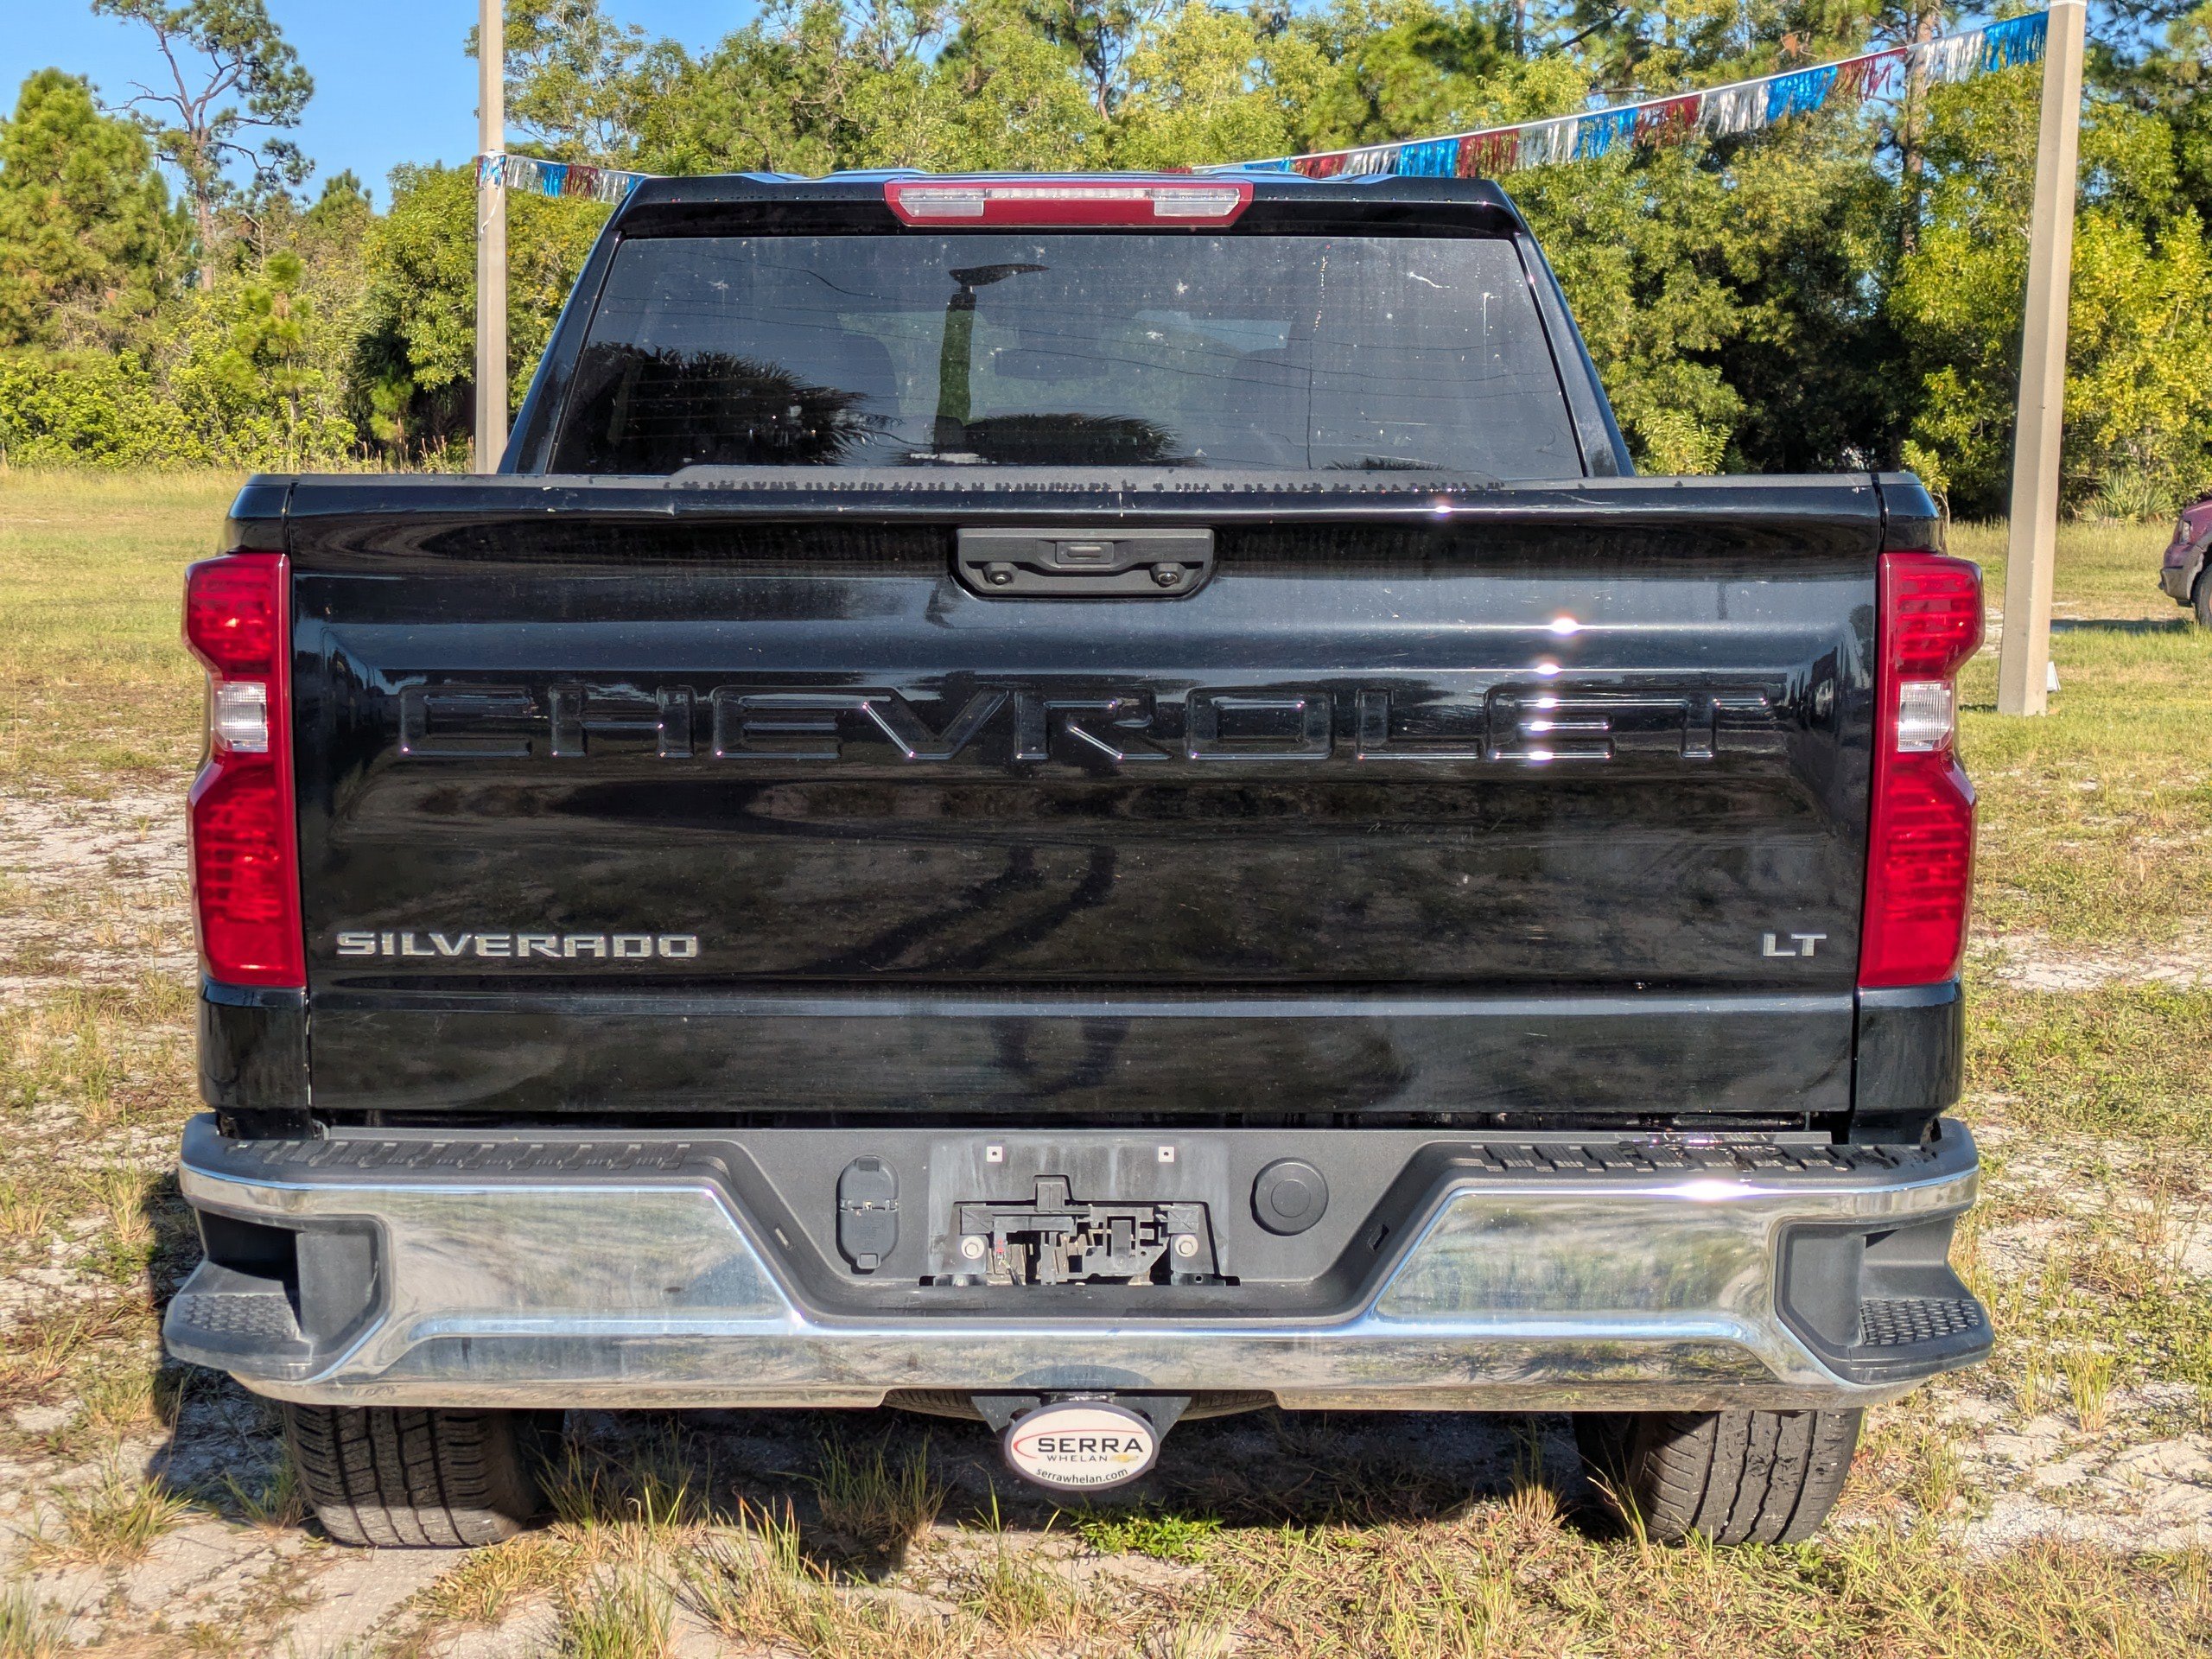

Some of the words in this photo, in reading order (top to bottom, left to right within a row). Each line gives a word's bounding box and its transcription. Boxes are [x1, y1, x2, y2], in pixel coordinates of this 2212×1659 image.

[398, 684, 1768, 760] CHEVROLET
[336, 932, 698, 958] SILVERADO
[1763, 933, 1827, 957] LT
[1038, 1438, 1144, 1453] SERRA
[1036, 1468, 1128, 1484] serrawhelan.com
